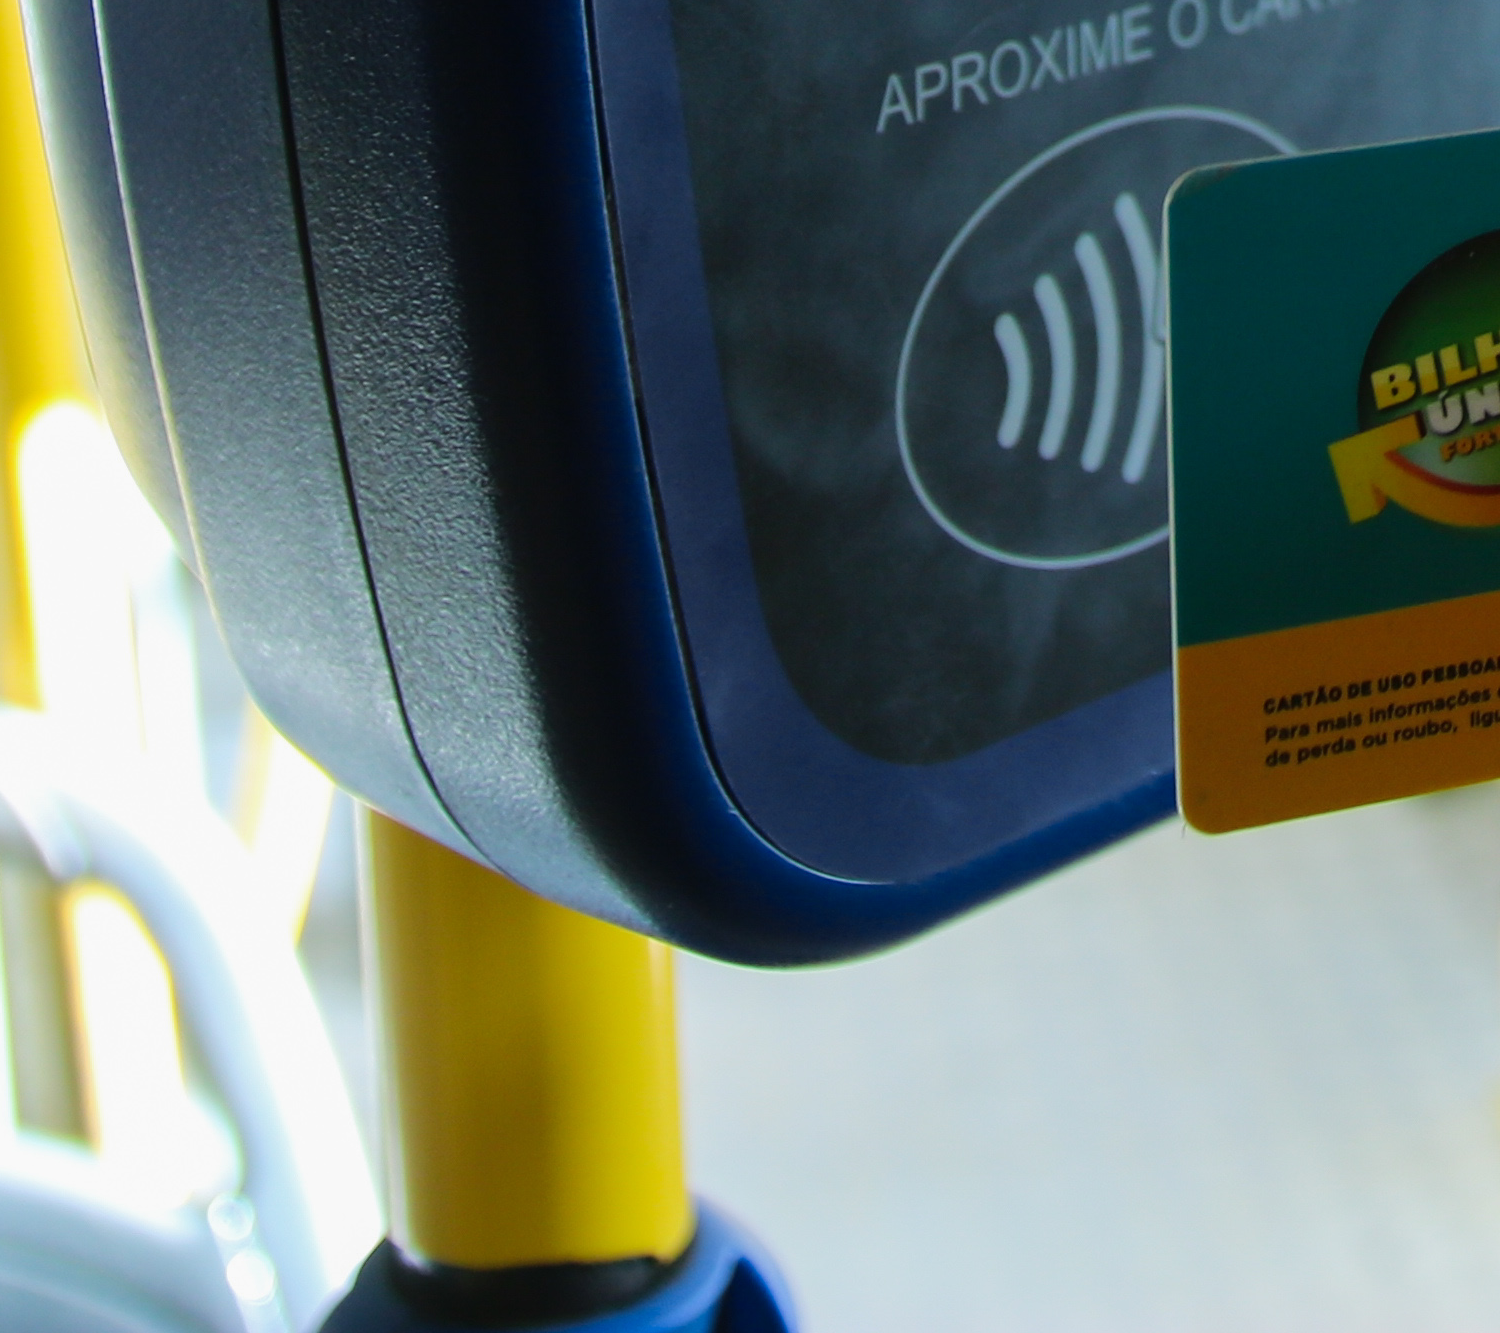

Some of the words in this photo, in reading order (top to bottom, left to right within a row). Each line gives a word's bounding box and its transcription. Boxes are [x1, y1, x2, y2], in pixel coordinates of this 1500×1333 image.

[876, 1, 1154, 133] APROXIME
[1262, 683, 1343, 716] CARTÃO
[1347, 679, 1374, 700] DE
[1378, 671, 1417, 695] USO
[1264, 720, 1311, 745] Para
[1316, 711, 1363, 735] mais
[1368, 686, 1492, 724] informações
[1265, 748, 1291, 769] de
[1296, 737, 1357, 765] perda
[1362, 729, 1389, 750] ou
